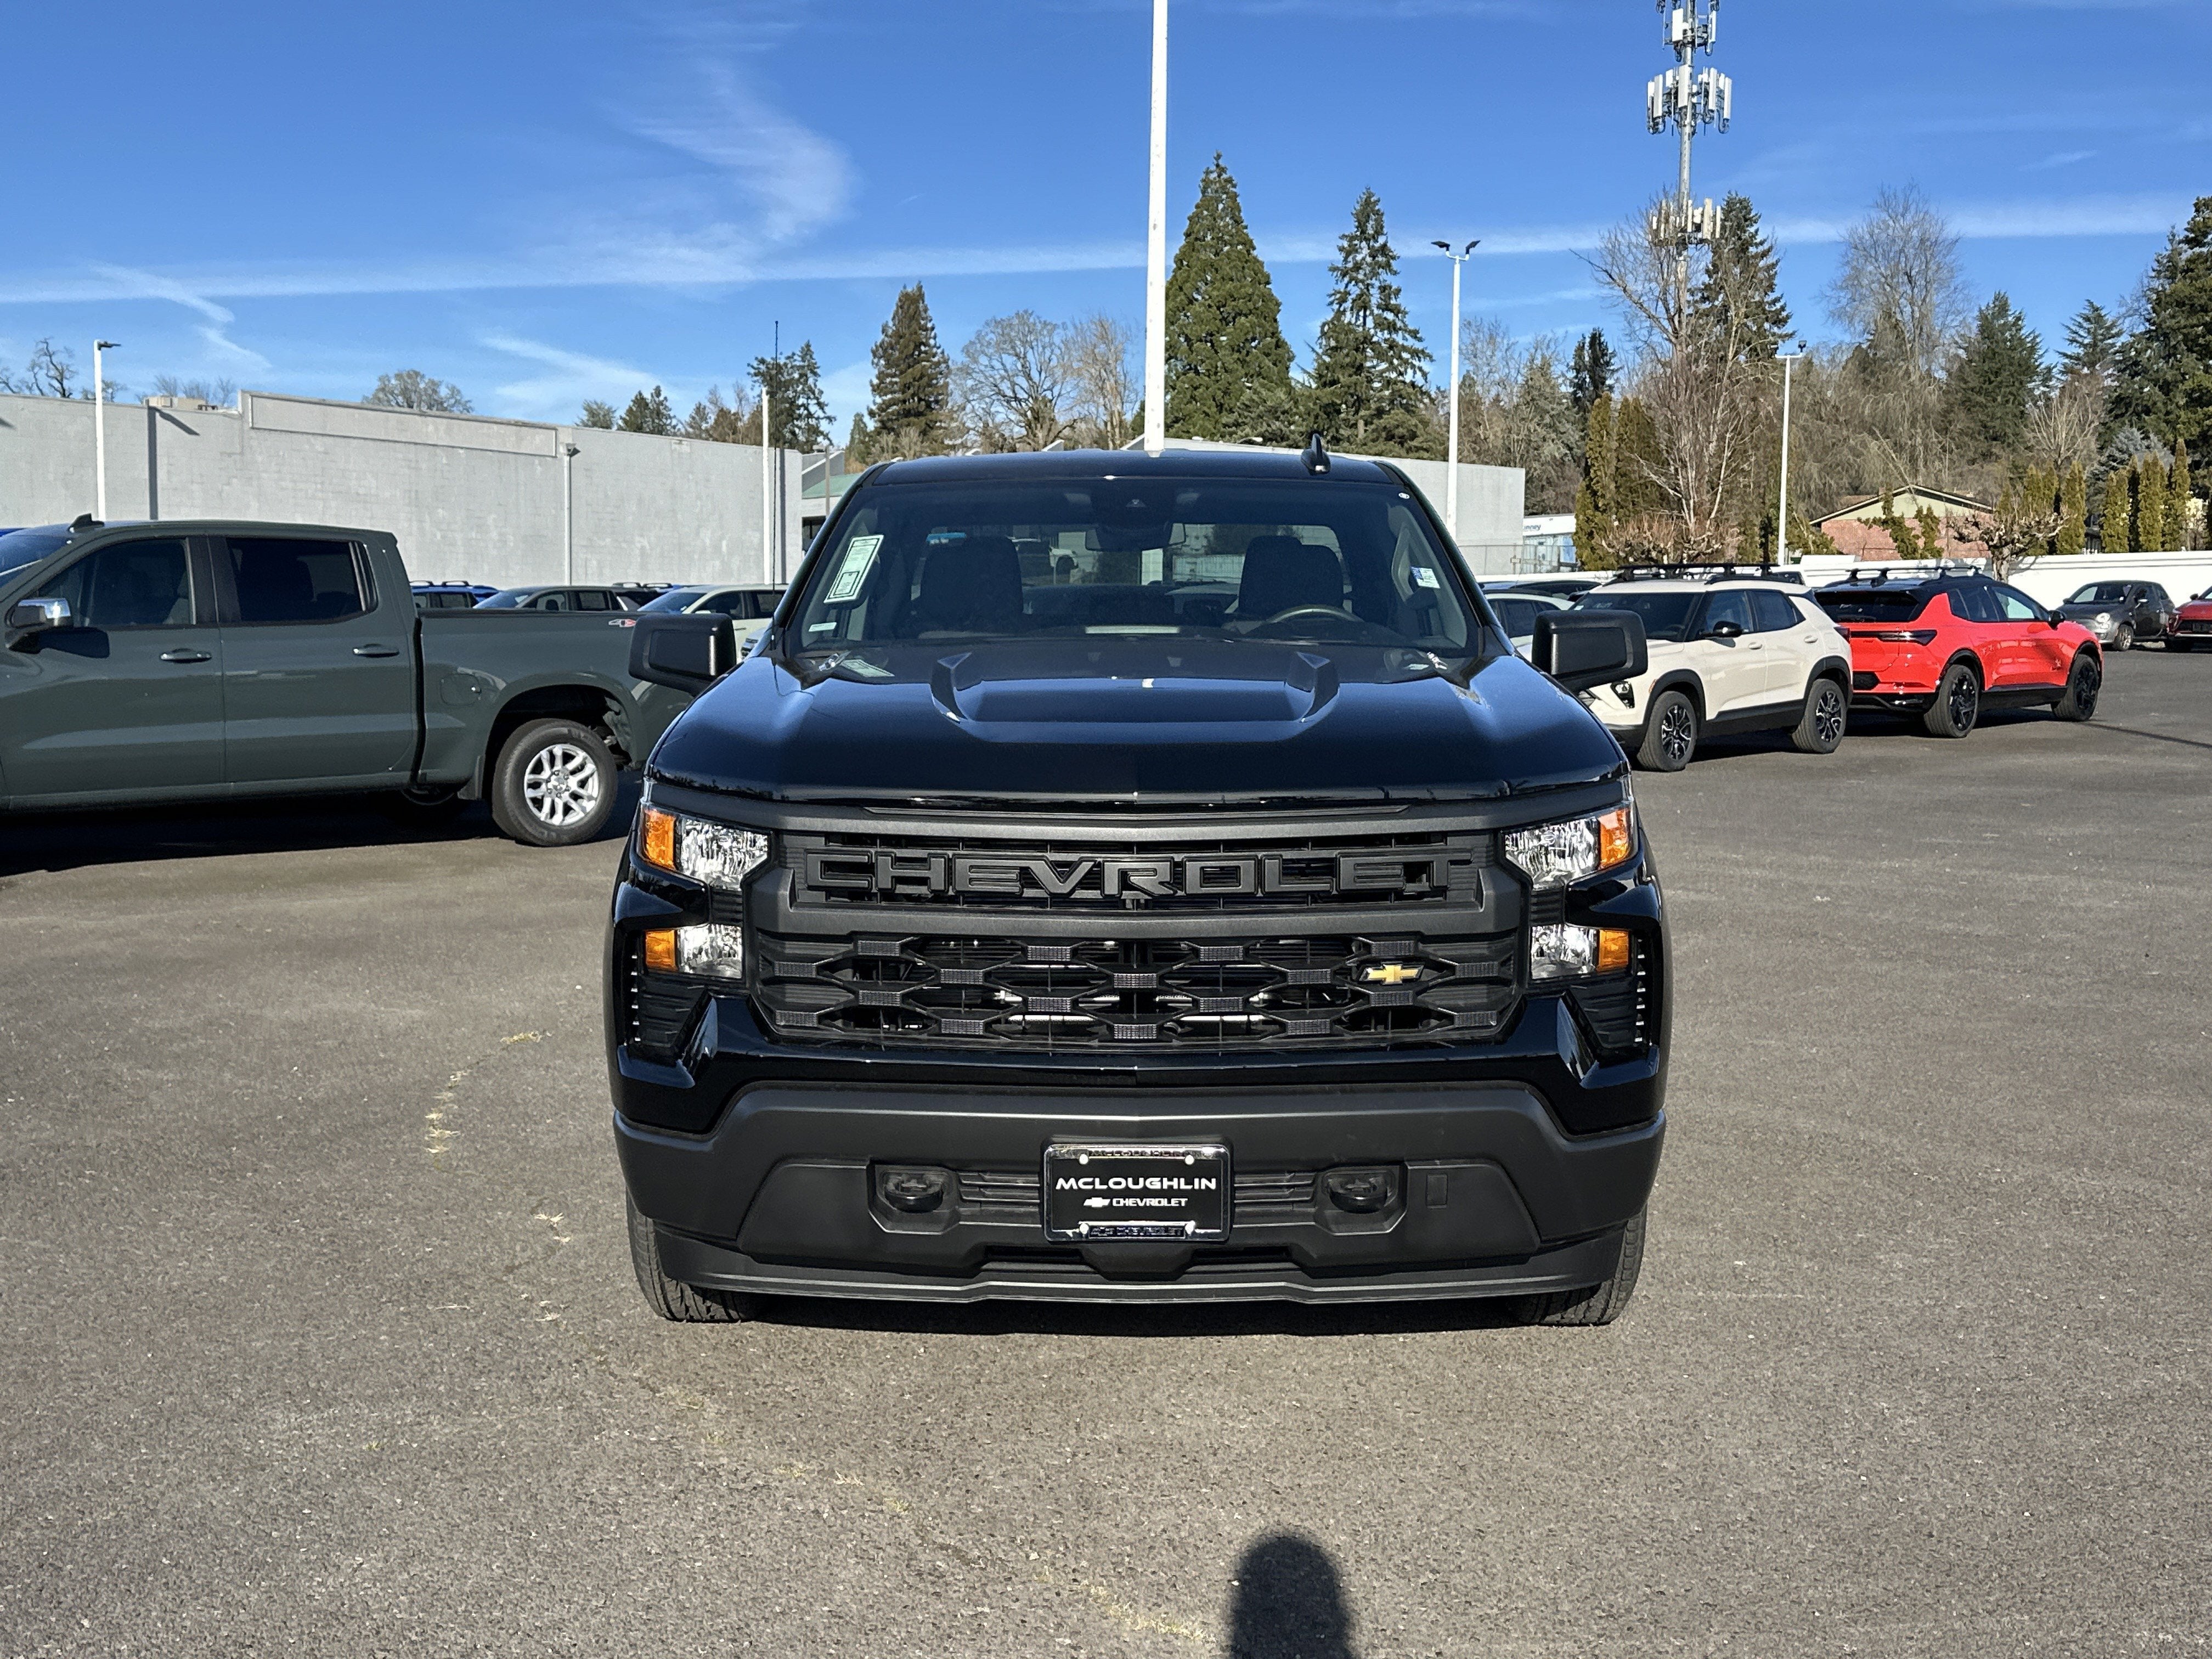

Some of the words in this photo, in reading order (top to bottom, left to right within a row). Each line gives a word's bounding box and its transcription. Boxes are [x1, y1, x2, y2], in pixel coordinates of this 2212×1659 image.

[805, 851, 1472, 896] CHEVROLET
[1055, 1177, 1216, 1190] MCLOUGHLIN
[1112, 1198, 1188, 1206] CHEVROLET
